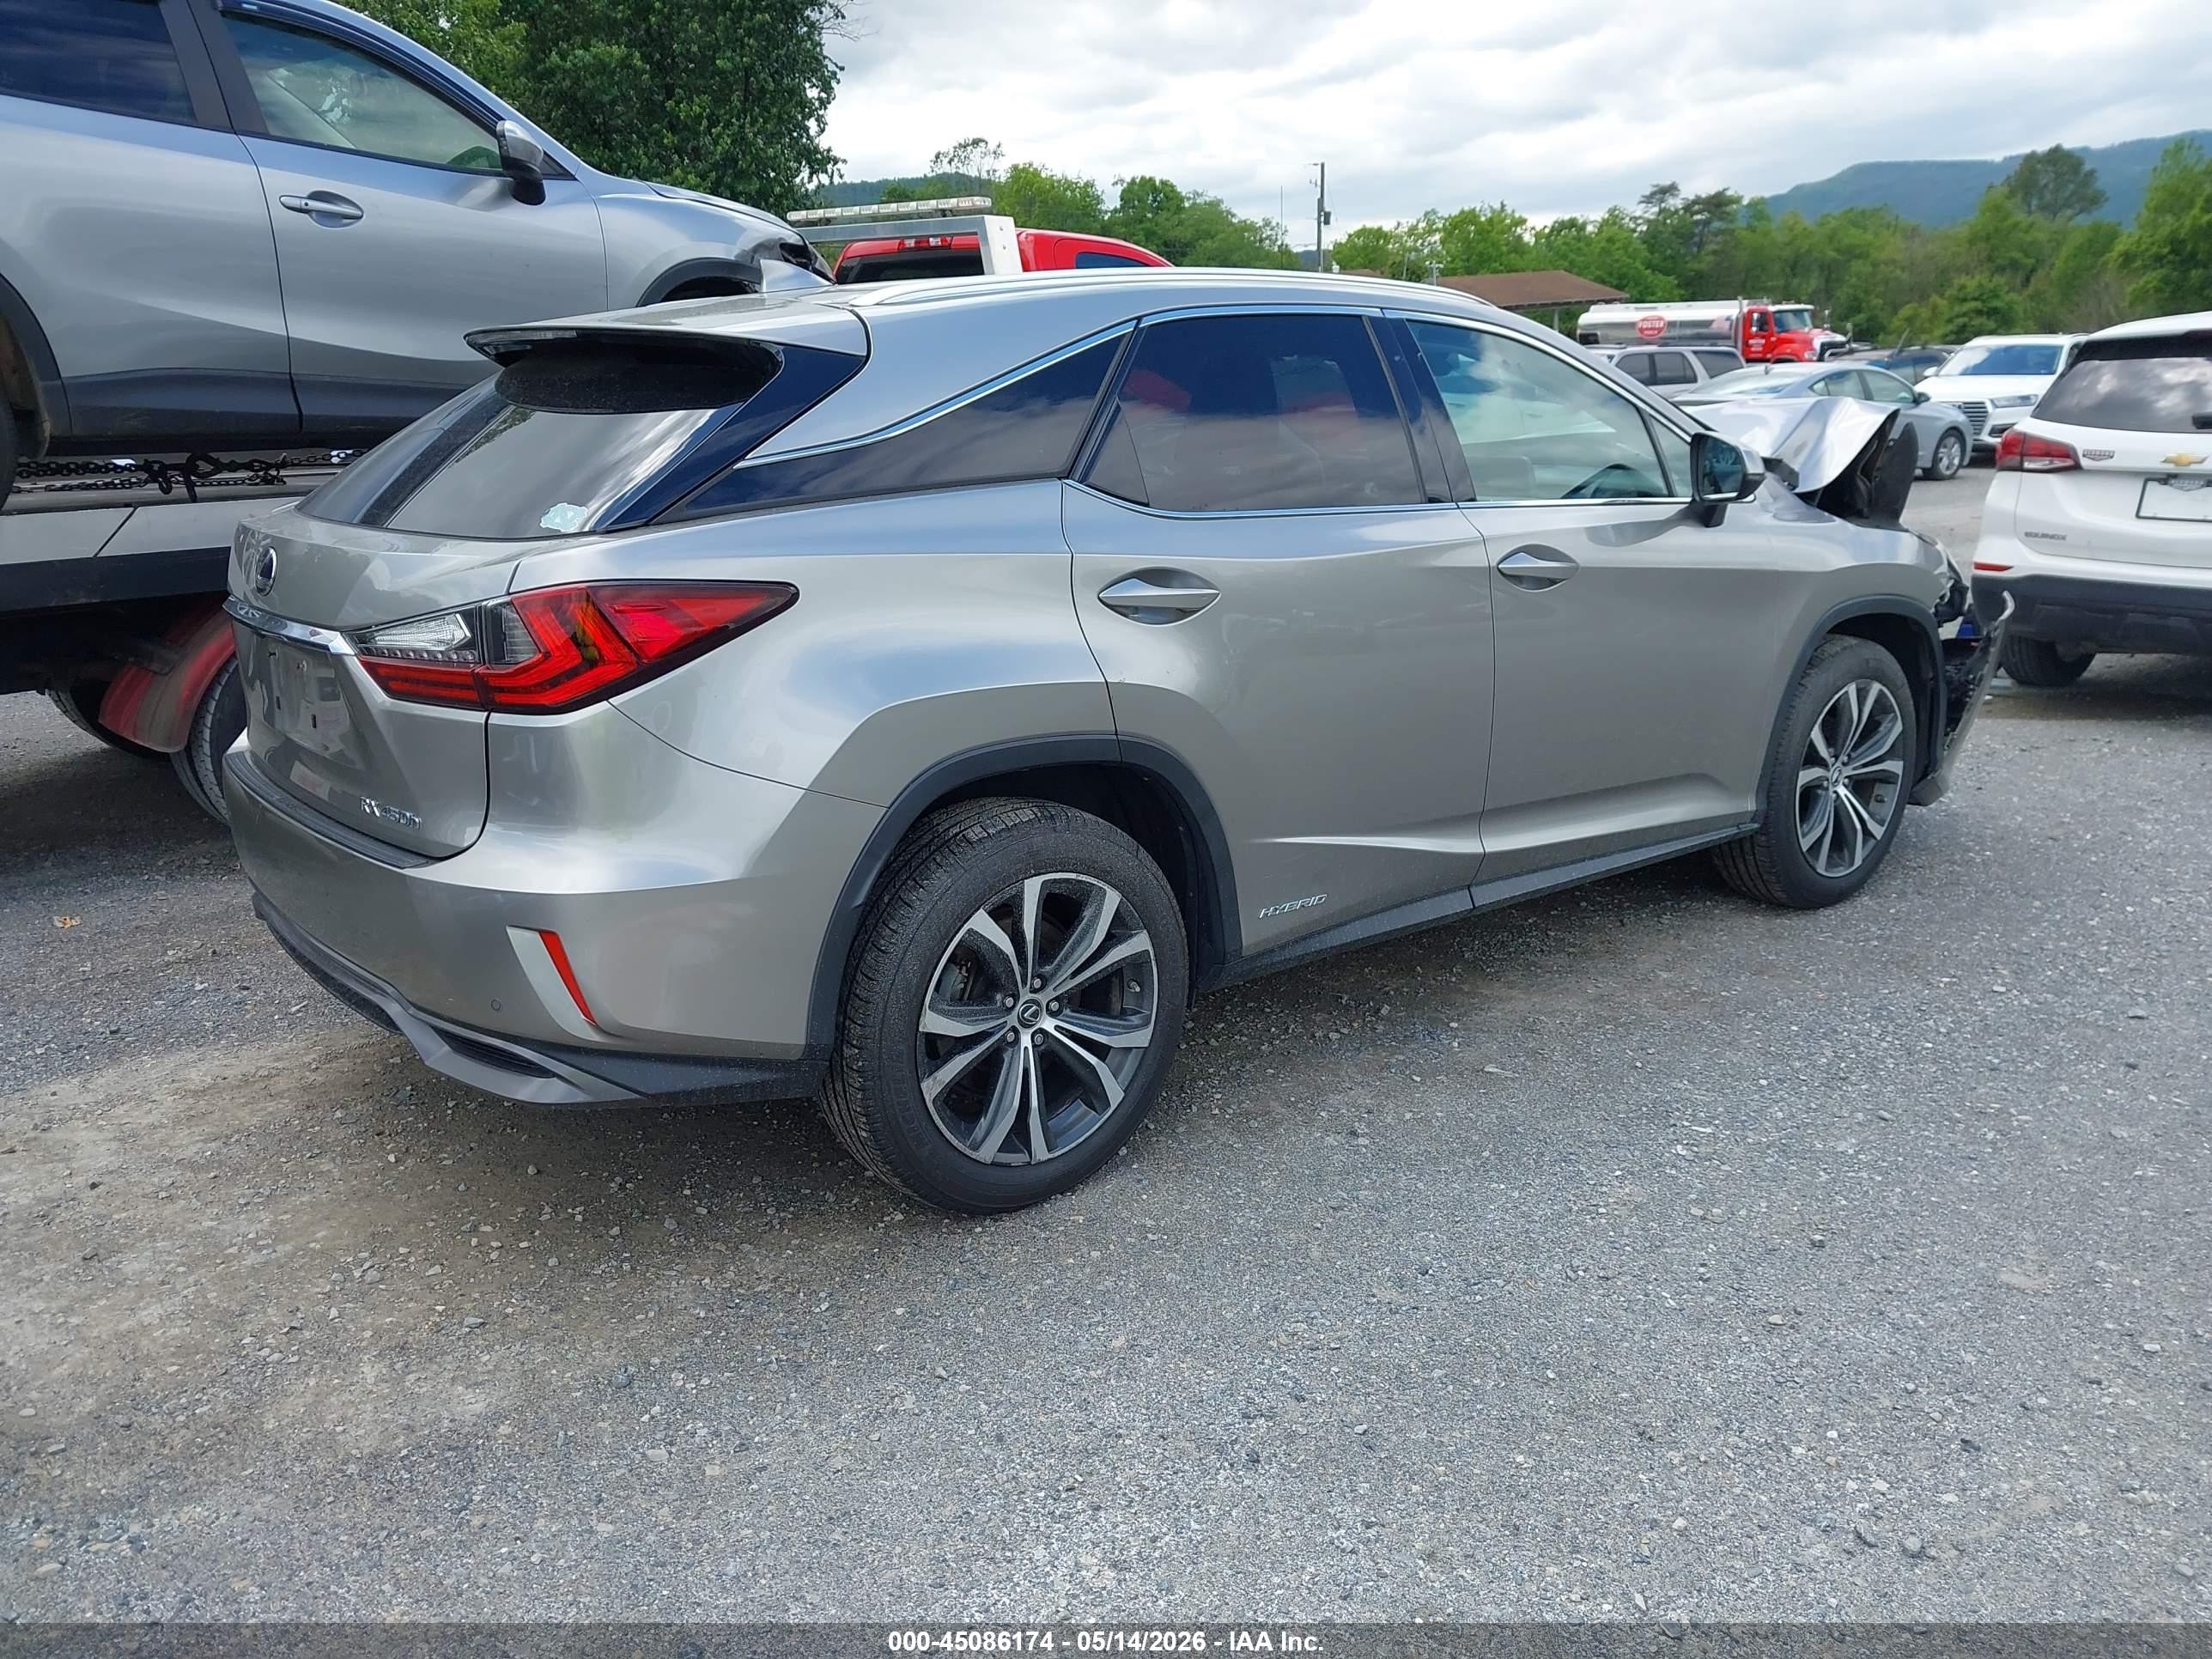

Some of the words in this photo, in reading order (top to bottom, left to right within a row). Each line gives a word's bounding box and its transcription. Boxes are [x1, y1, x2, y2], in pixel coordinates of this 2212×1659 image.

[360, 796, 380, 817] RX
[381, 805, 422, 830] 450h
[1259, 894, 1328, 919] HYBRID
